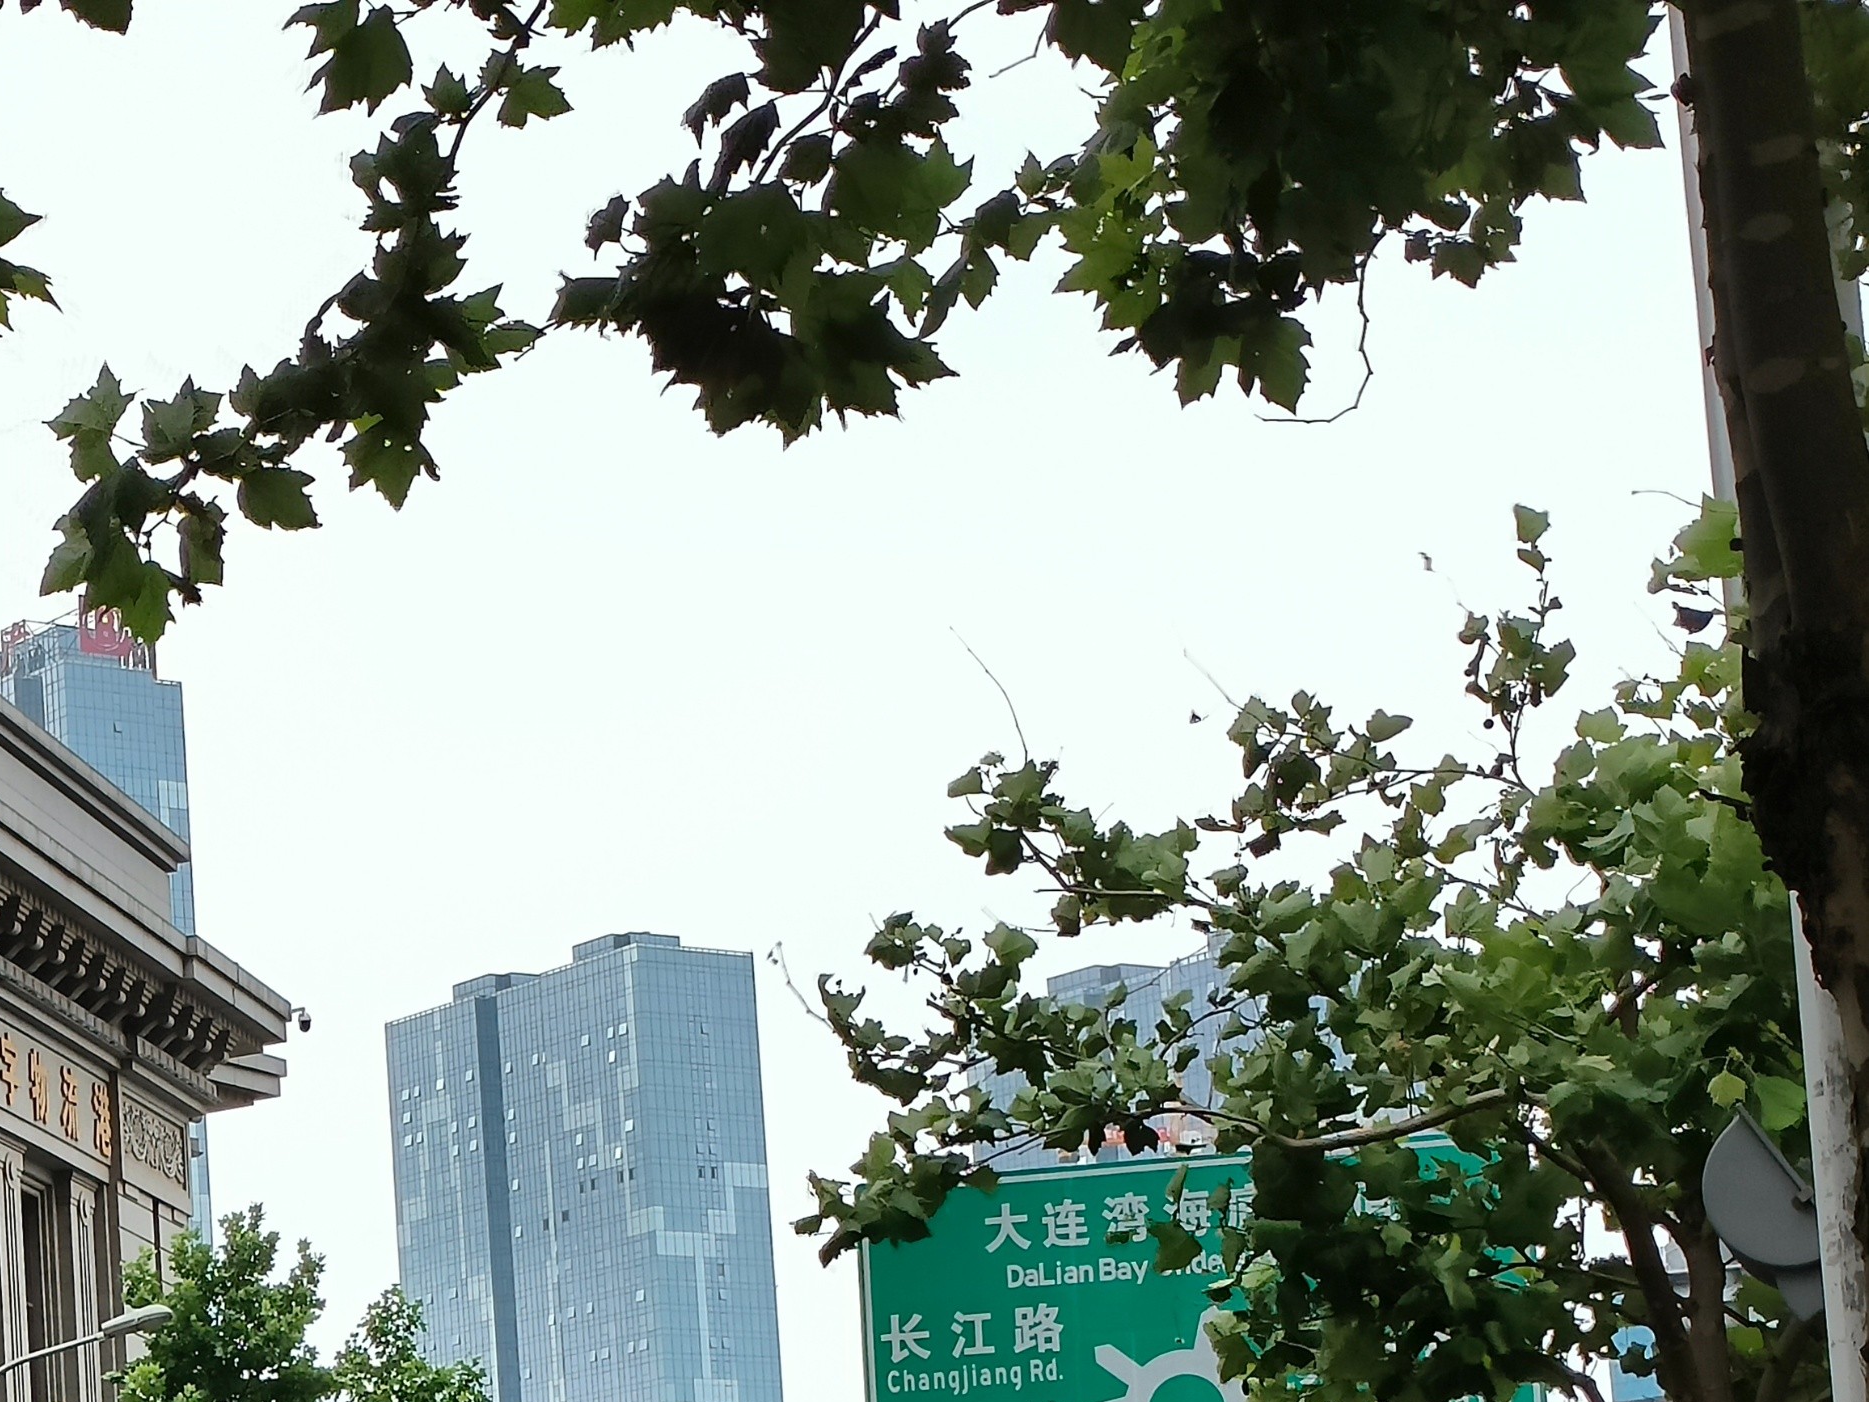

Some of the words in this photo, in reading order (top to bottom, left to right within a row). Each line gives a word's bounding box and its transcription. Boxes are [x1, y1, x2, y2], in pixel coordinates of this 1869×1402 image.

[1006, 1262, 1095, 1289] DaLian
[1098, 1256, 1149, 1286] Bay
[880, 1303, 1064, 1364] 长江路
[887, 1363, 1023, 1396] Changjiang
[1029, 1357, 1064, 1383] Rd.
